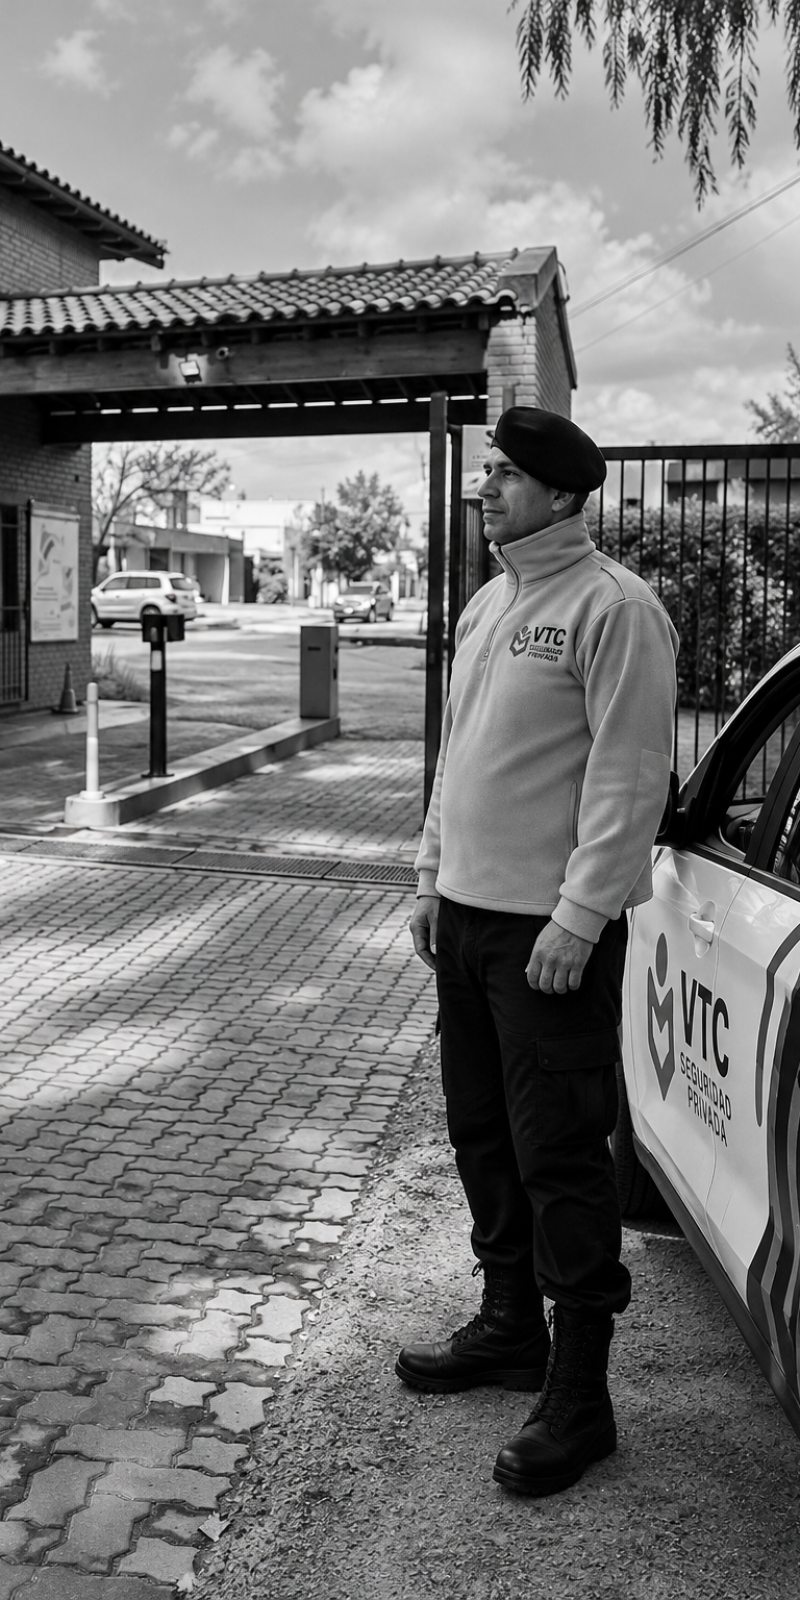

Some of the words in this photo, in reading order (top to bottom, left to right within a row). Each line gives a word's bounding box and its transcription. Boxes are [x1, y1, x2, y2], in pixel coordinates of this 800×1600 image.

[533, 626, 567, 647] VTC
[680, 969, 730, 1078] VTC
[680, 1051, 732, 1121] SEGURIDAD
[687, 1085, 728, 1148] PRIVADA
